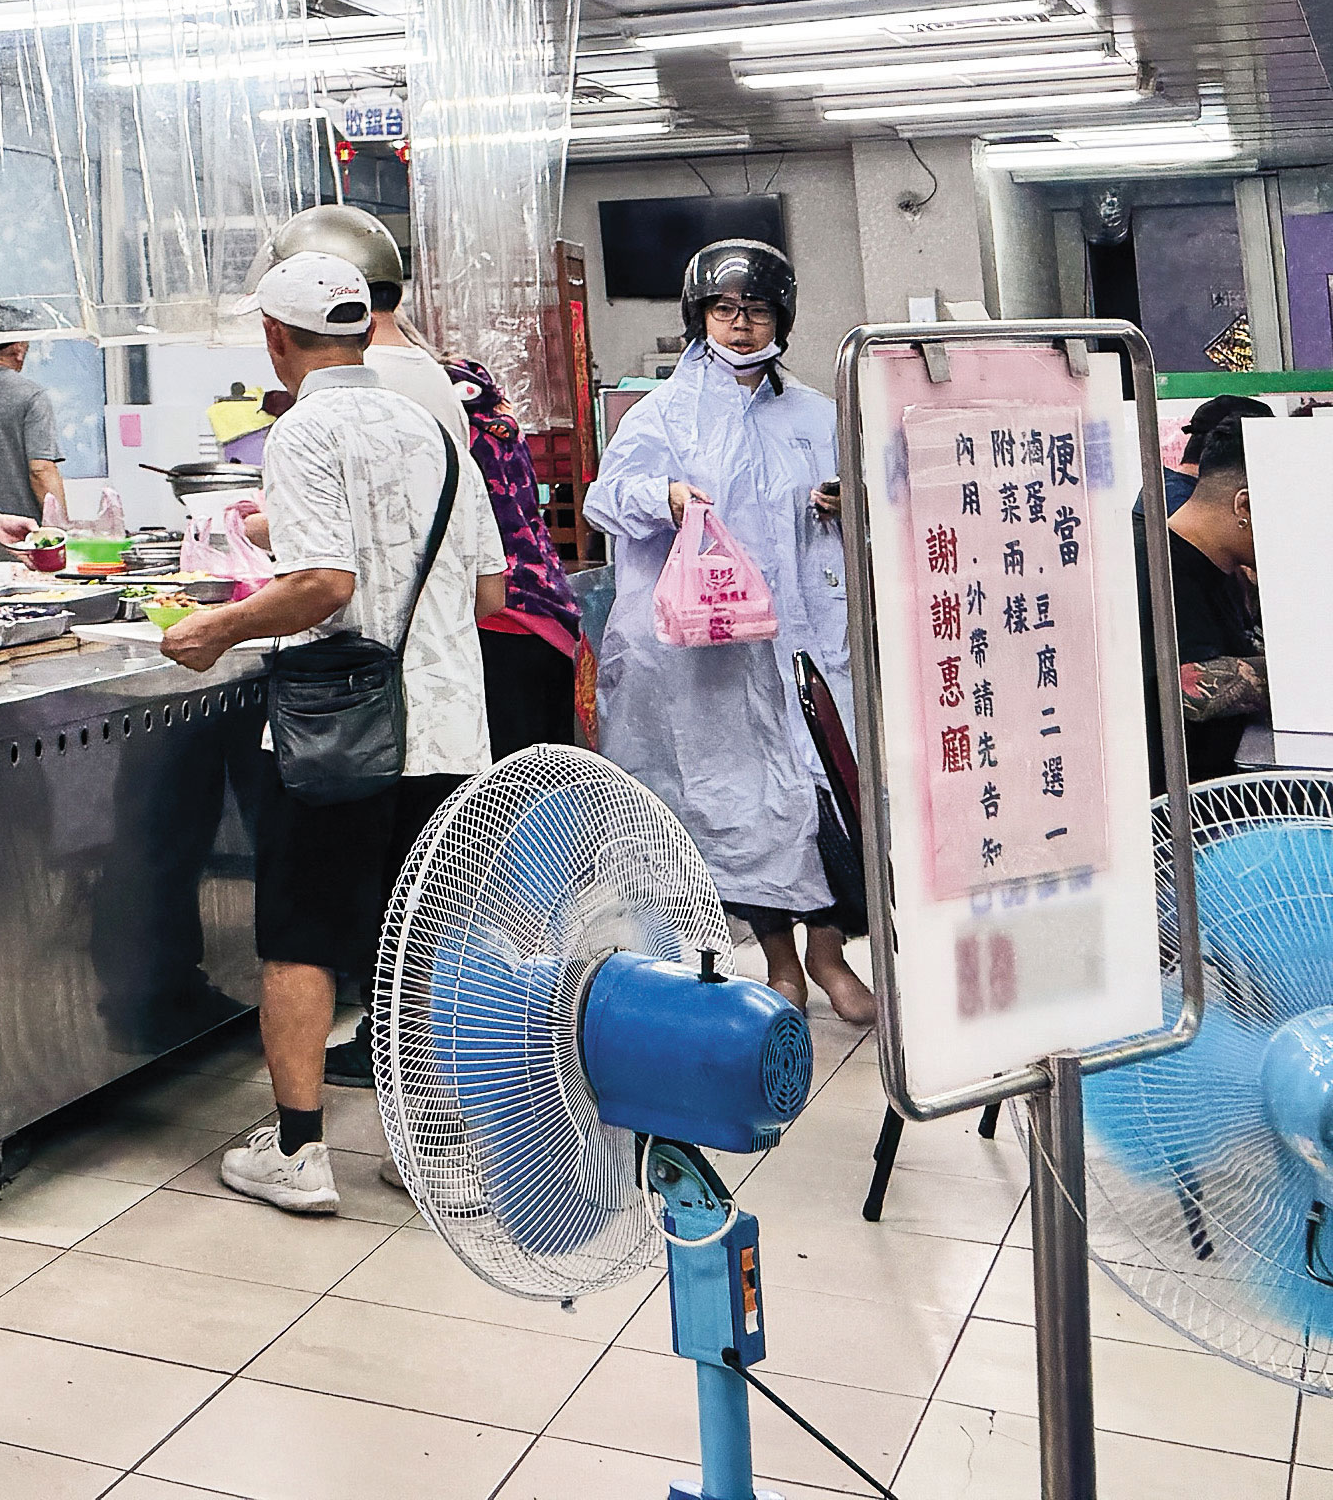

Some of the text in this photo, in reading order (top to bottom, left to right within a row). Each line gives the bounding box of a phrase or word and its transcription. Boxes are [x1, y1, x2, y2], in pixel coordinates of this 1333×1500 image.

[991, 428, 1030, 635] 附菜兩樣
[1047, 433, 1081, 567] 便當
[926, 524, 973, 773] 謝謝惠顧
